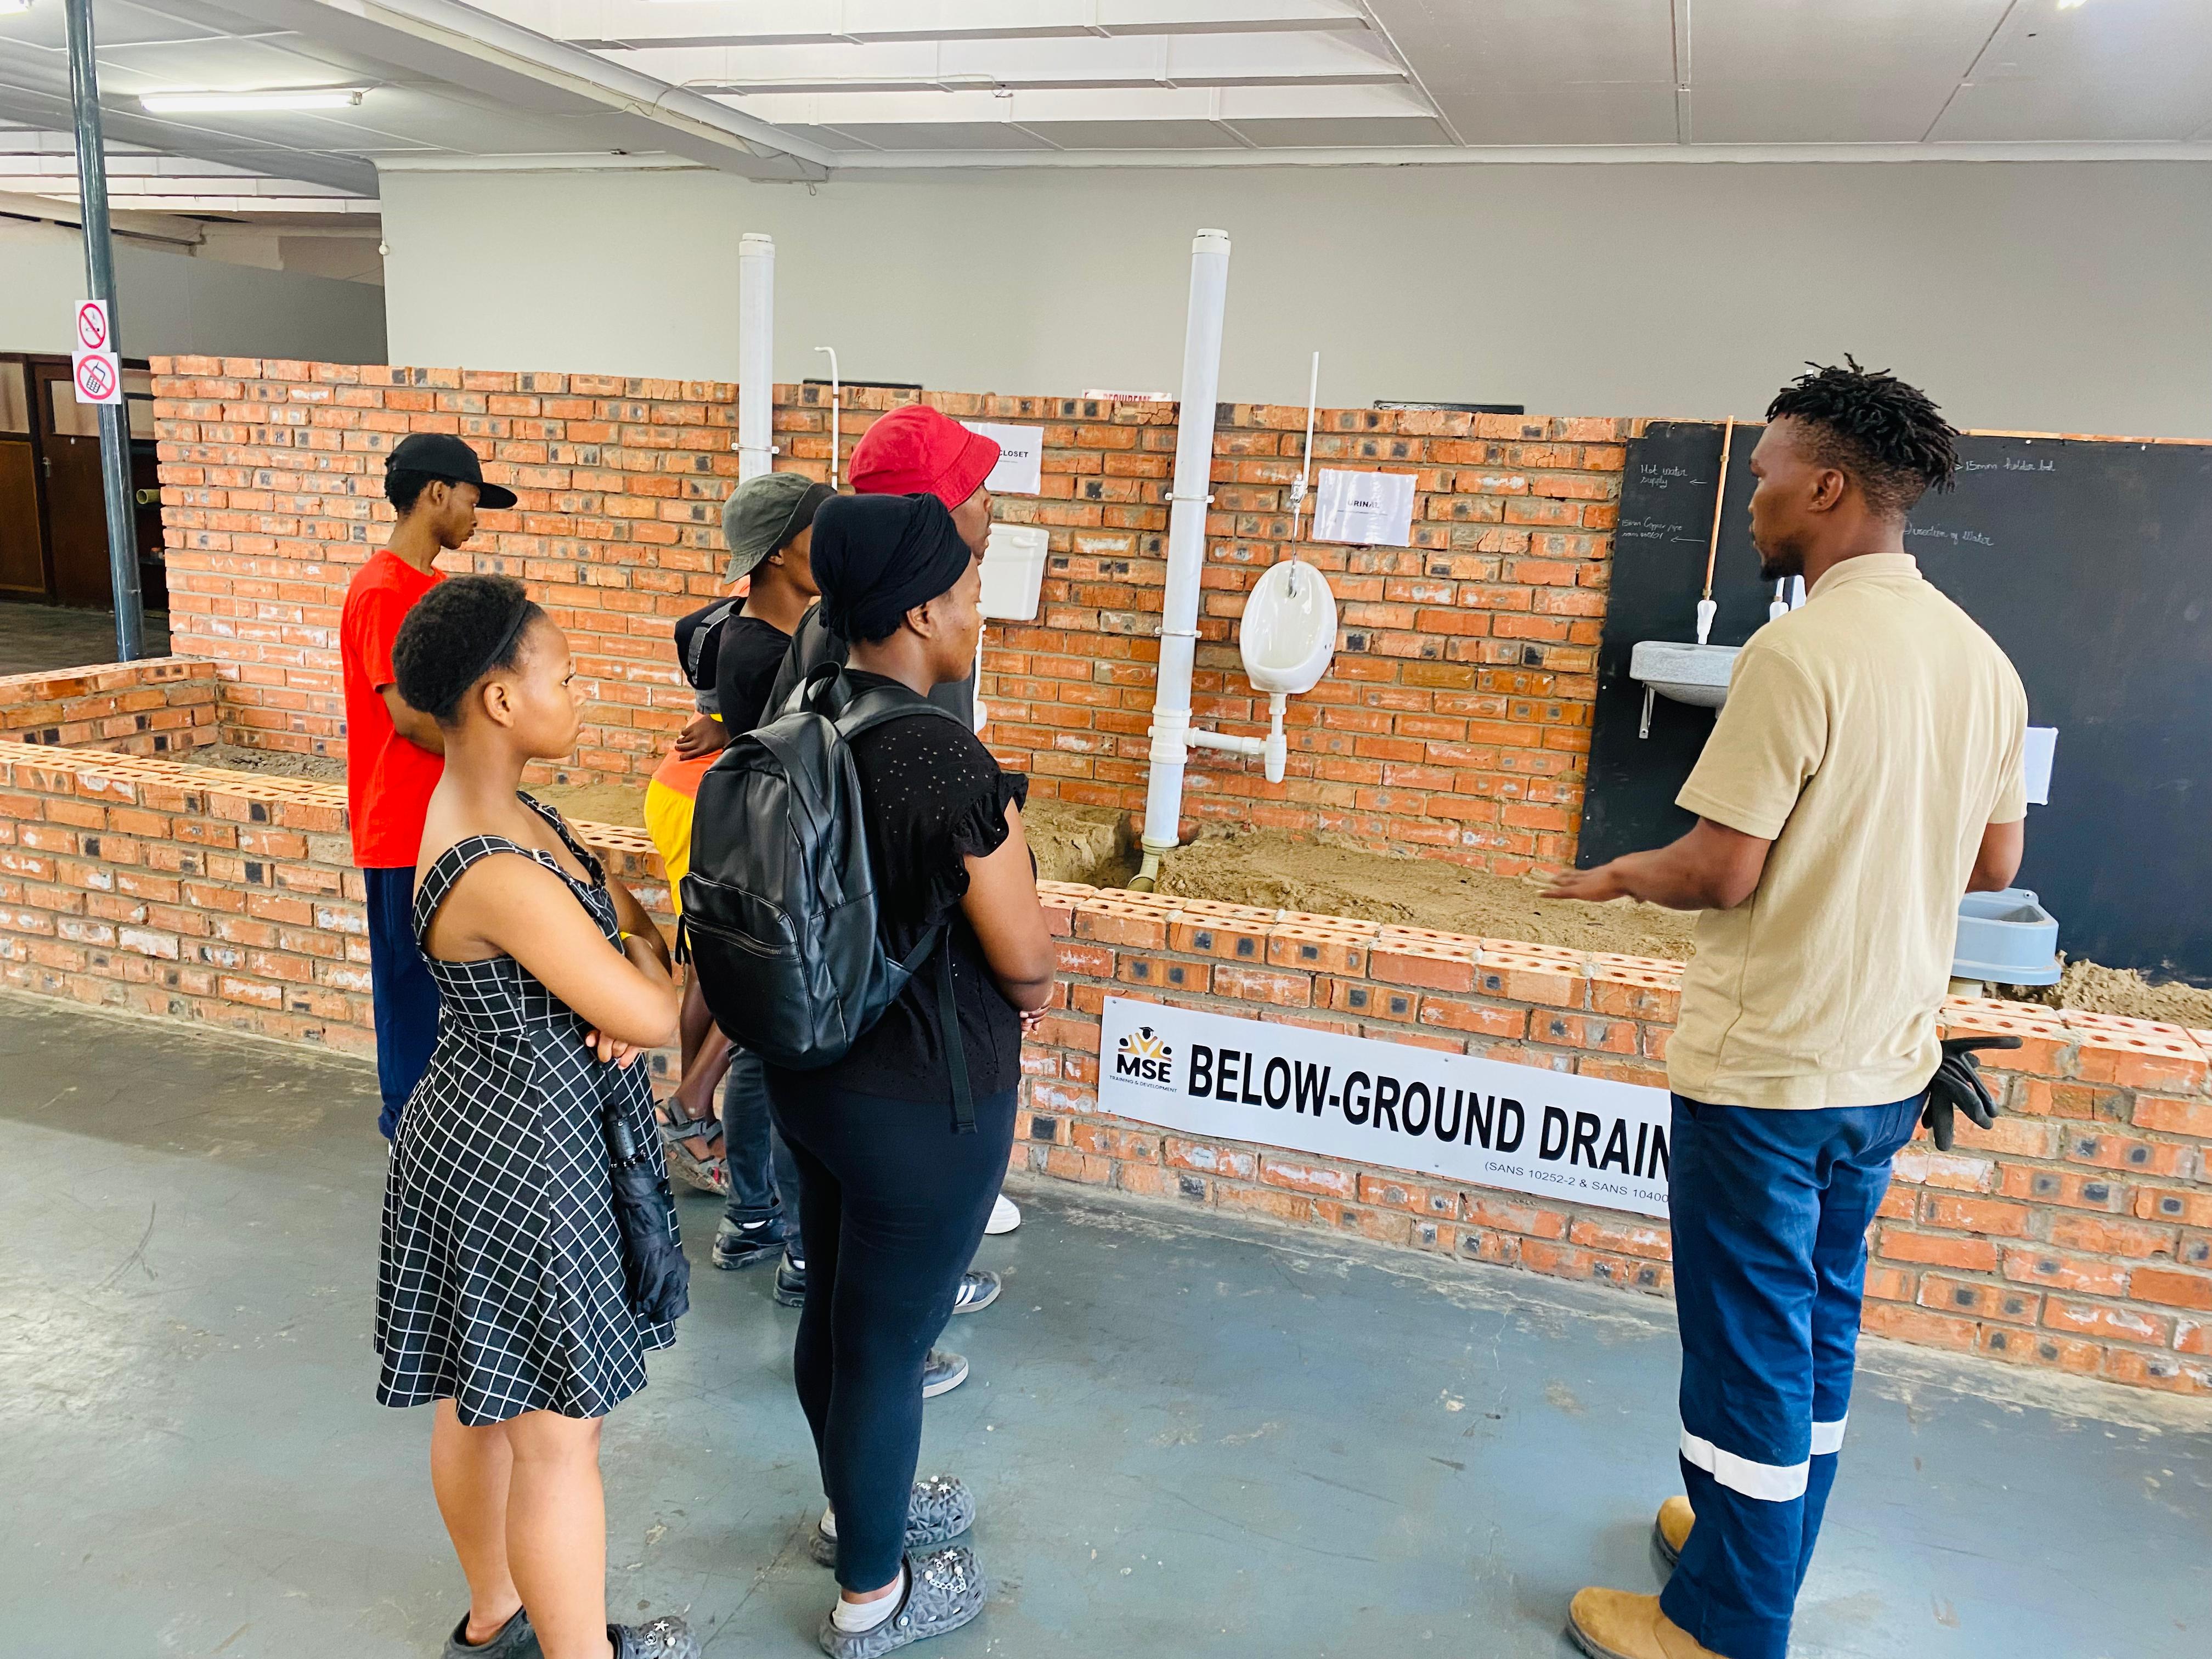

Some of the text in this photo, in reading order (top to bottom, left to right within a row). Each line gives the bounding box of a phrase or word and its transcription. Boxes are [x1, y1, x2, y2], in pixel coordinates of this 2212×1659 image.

[1641, 464, 1658, 475] Hot
[1347, 500, 1380, 509] URINAL
[1116, 1053, 1172, 1084] MSE
[1109, 1075, 1133, 1085] TRAINING
[1140, 1081, 1177, 1093] DEVELOPMENT
[1188, 1043, 1525, 1153] BELOW-GROUND
[1485, 1161, 1669, 1203] (SANS 10252-2 & SANS 10400
